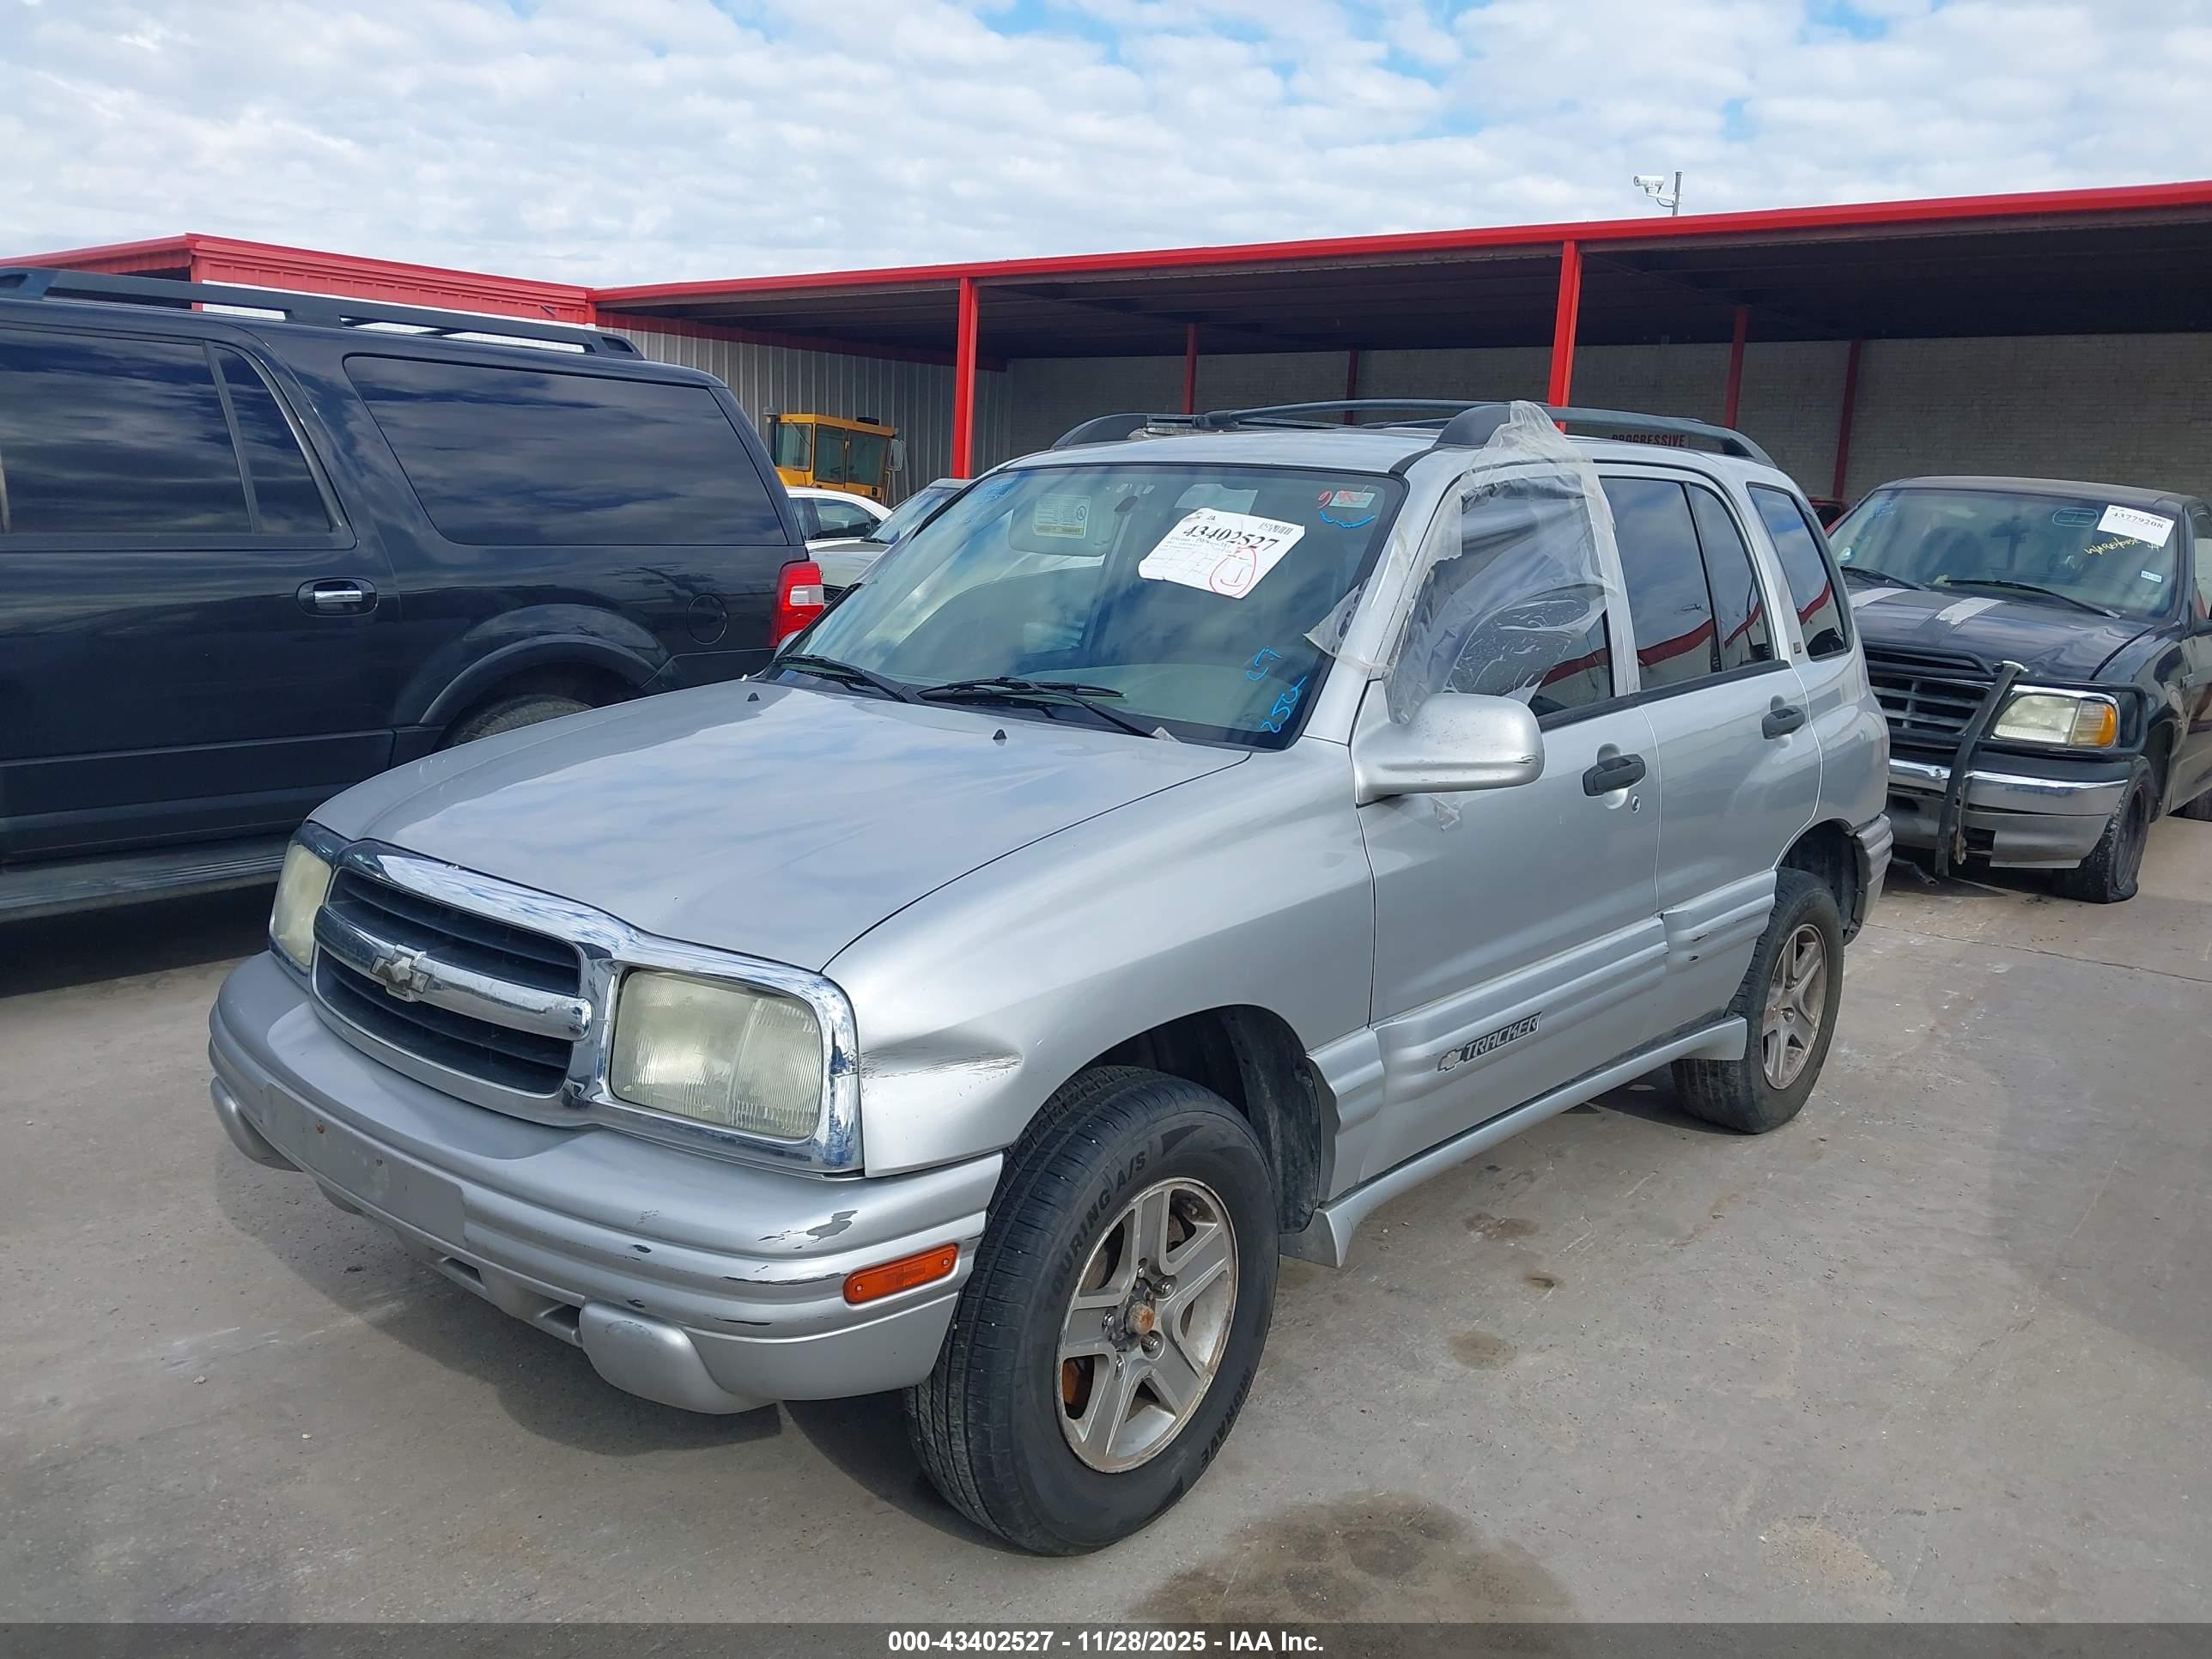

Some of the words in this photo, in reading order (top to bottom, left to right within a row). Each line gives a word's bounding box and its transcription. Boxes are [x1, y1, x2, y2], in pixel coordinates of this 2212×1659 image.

[1182, 525, 1280, 551] 43402527
[1466, 1013, 1540, 1060] TRACKER
[1116, 1151, 1146, 1191] A/S
